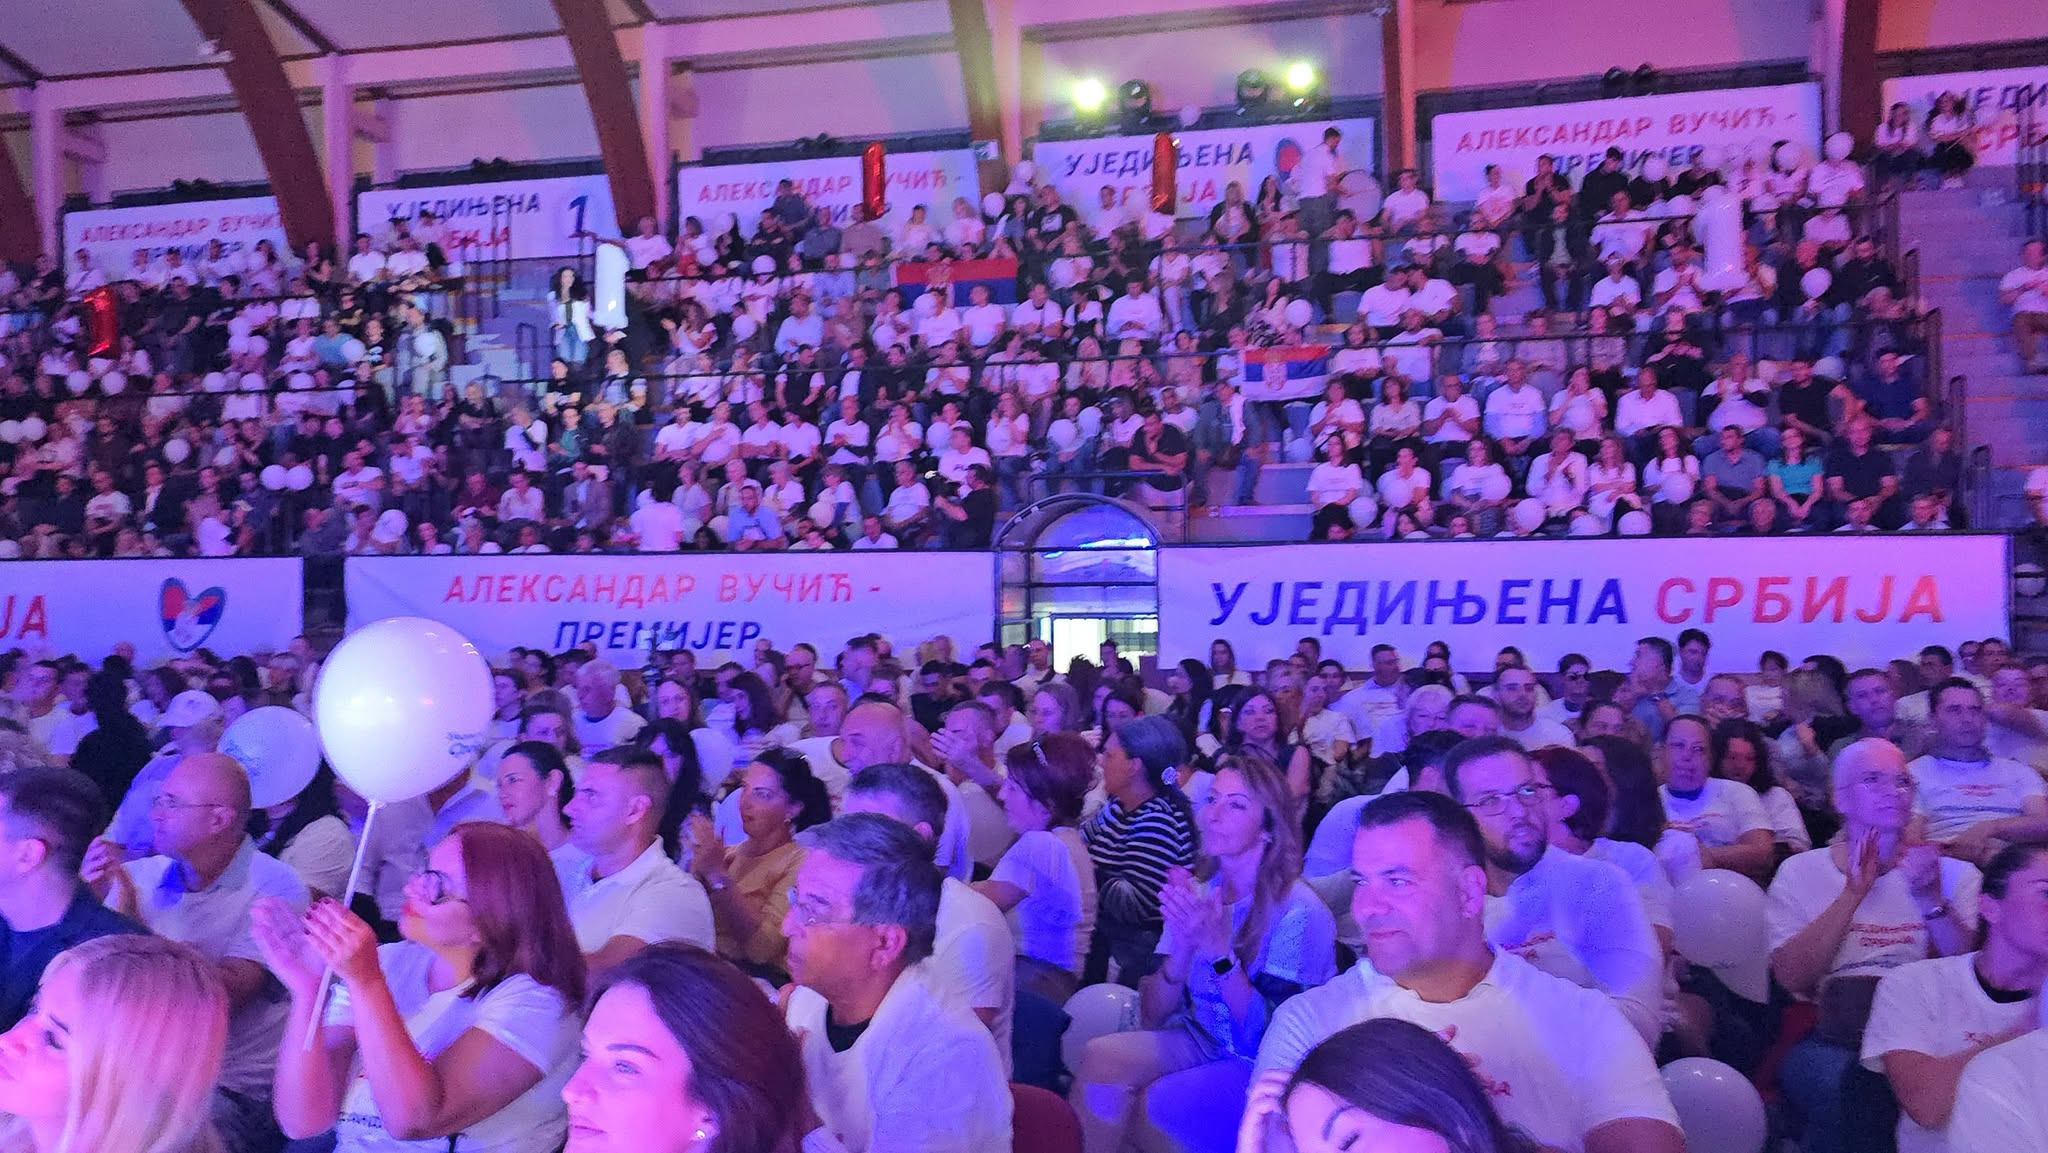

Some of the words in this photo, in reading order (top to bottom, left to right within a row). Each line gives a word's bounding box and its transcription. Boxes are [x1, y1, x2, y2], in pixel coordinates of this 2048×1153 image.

[1455, 116, 1655, 153] АЛЕКСАНДАР
[1667, 106, 1777, 135] ВУЧИЋ
[443, 573, 698, 609] АЛЕКСАНДАР
[718, 573, 855, 602] ВУЧИЋ
[1208, 578, 1631, 636] УЈЕДИЊЕНА
[1654, 575, 1947, 625] СРБИЈА
